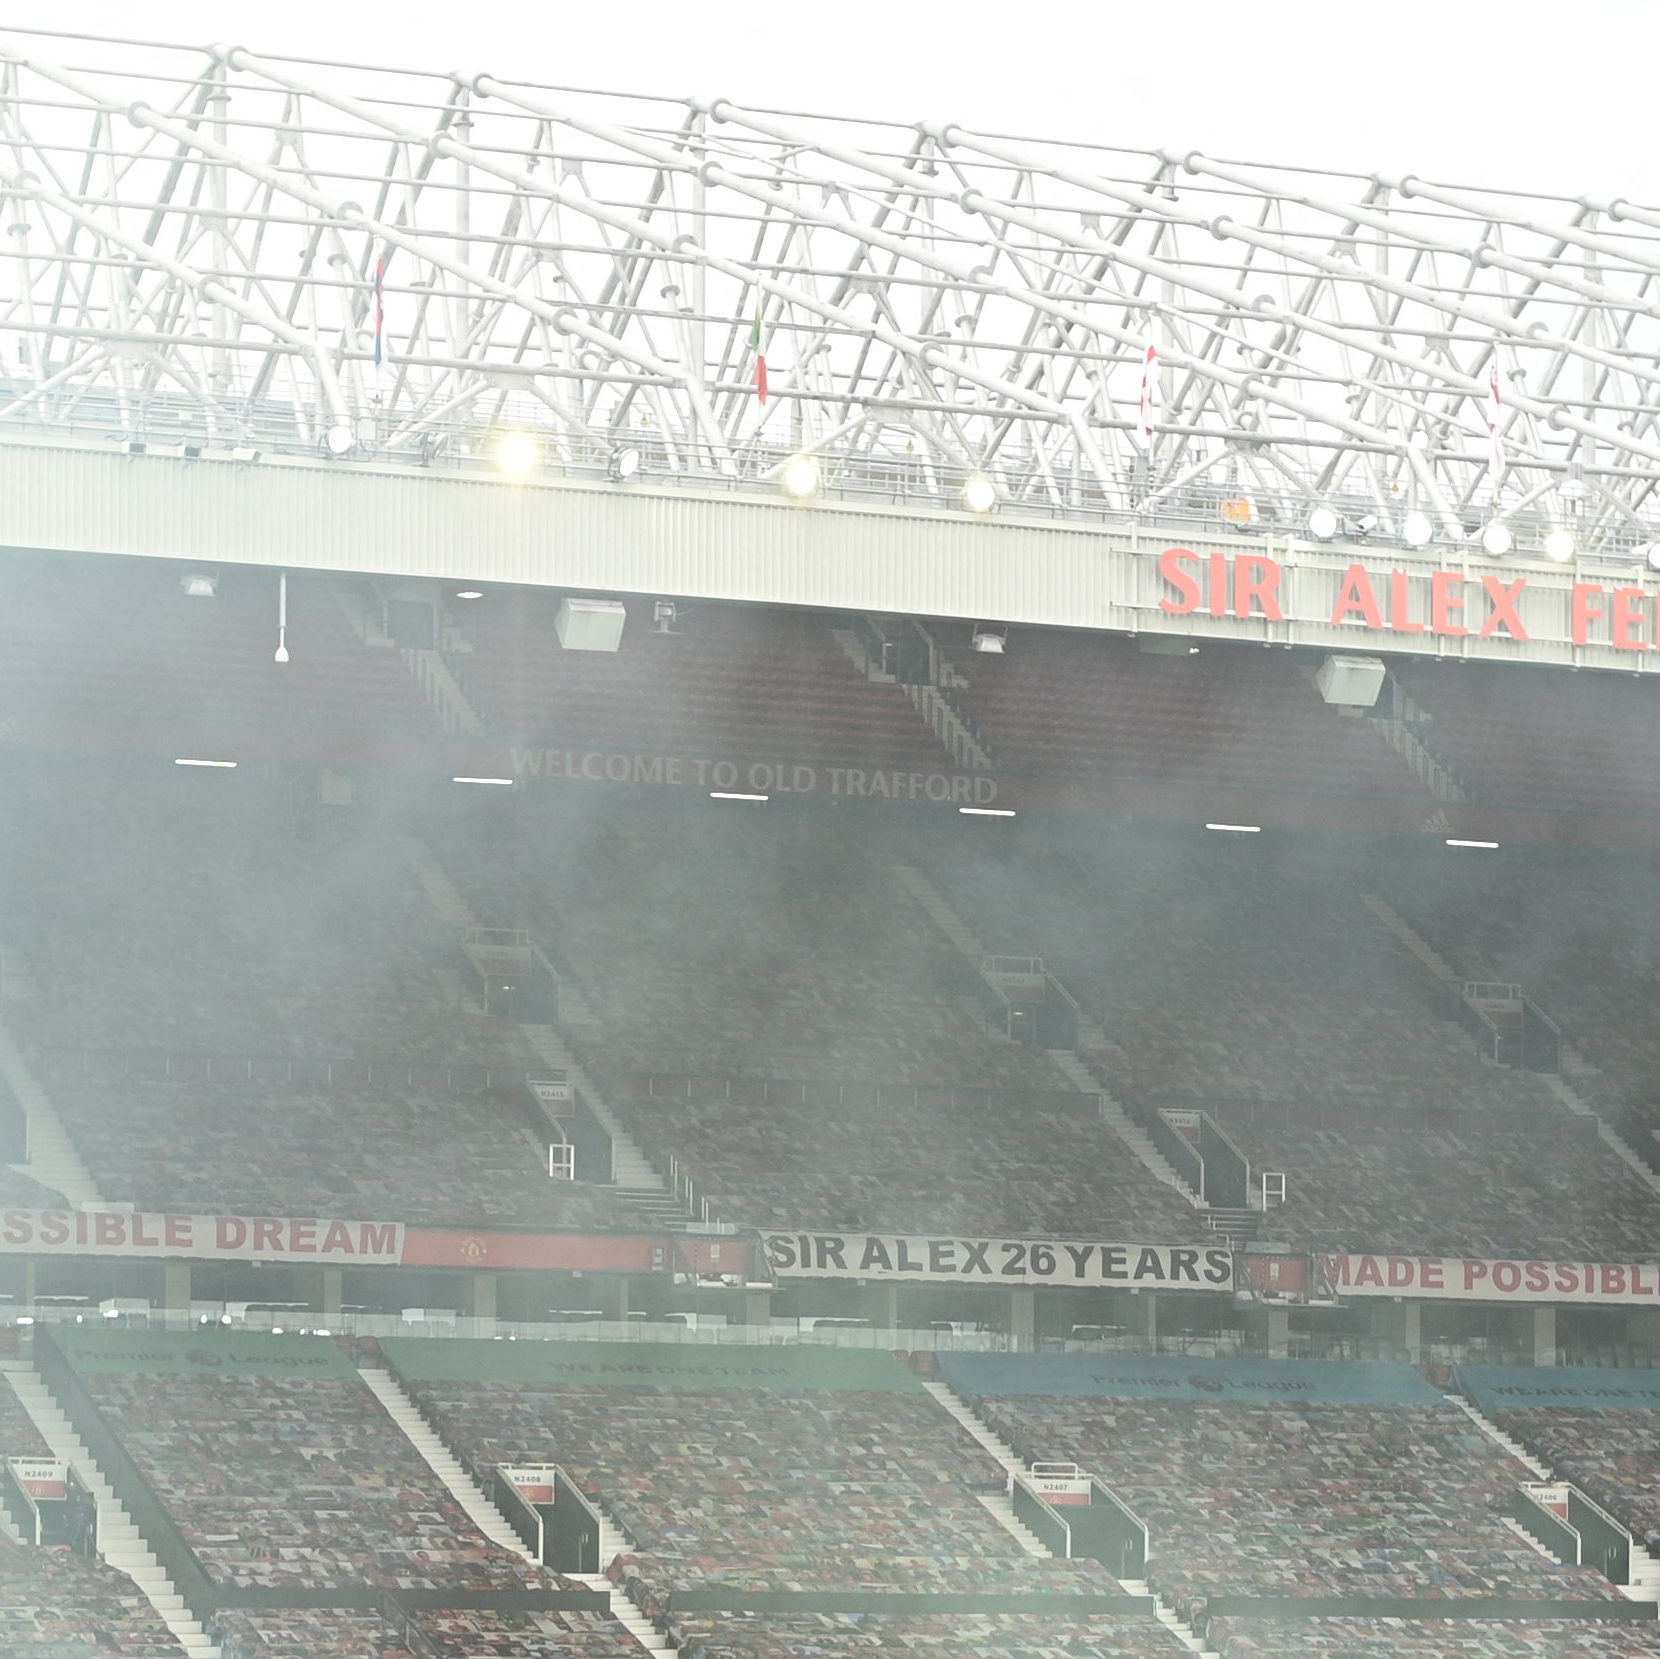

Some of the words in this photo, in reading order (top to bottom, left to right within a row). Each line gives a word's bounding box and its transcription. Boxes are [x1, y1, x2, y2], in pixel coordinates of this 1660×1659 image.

[1158, 548, 1286, 621] SIR
[1331, 563, 1531, 642] ALEX
[510, 746, 682, 786] WELCOME
[691, 758, 739, 790] TO
[747, 762, 817, 795] OLD
[827, 767, 999, 803] TRAFFORD
[215, 1216, 397, 1256] DREAM
[770, 1234, 847, 1269] SIR
[859, 1236, 993, 1274] ALEX
[1000, 1241, 1057, 1276] 26
[1063, 1246, 1232, 1284] YEARS
[1320, 1255, 1445, 1289] MADE
[25, 1470, 53, 1478] N2409
[1043, 1483, 1068, 1491] N2407
